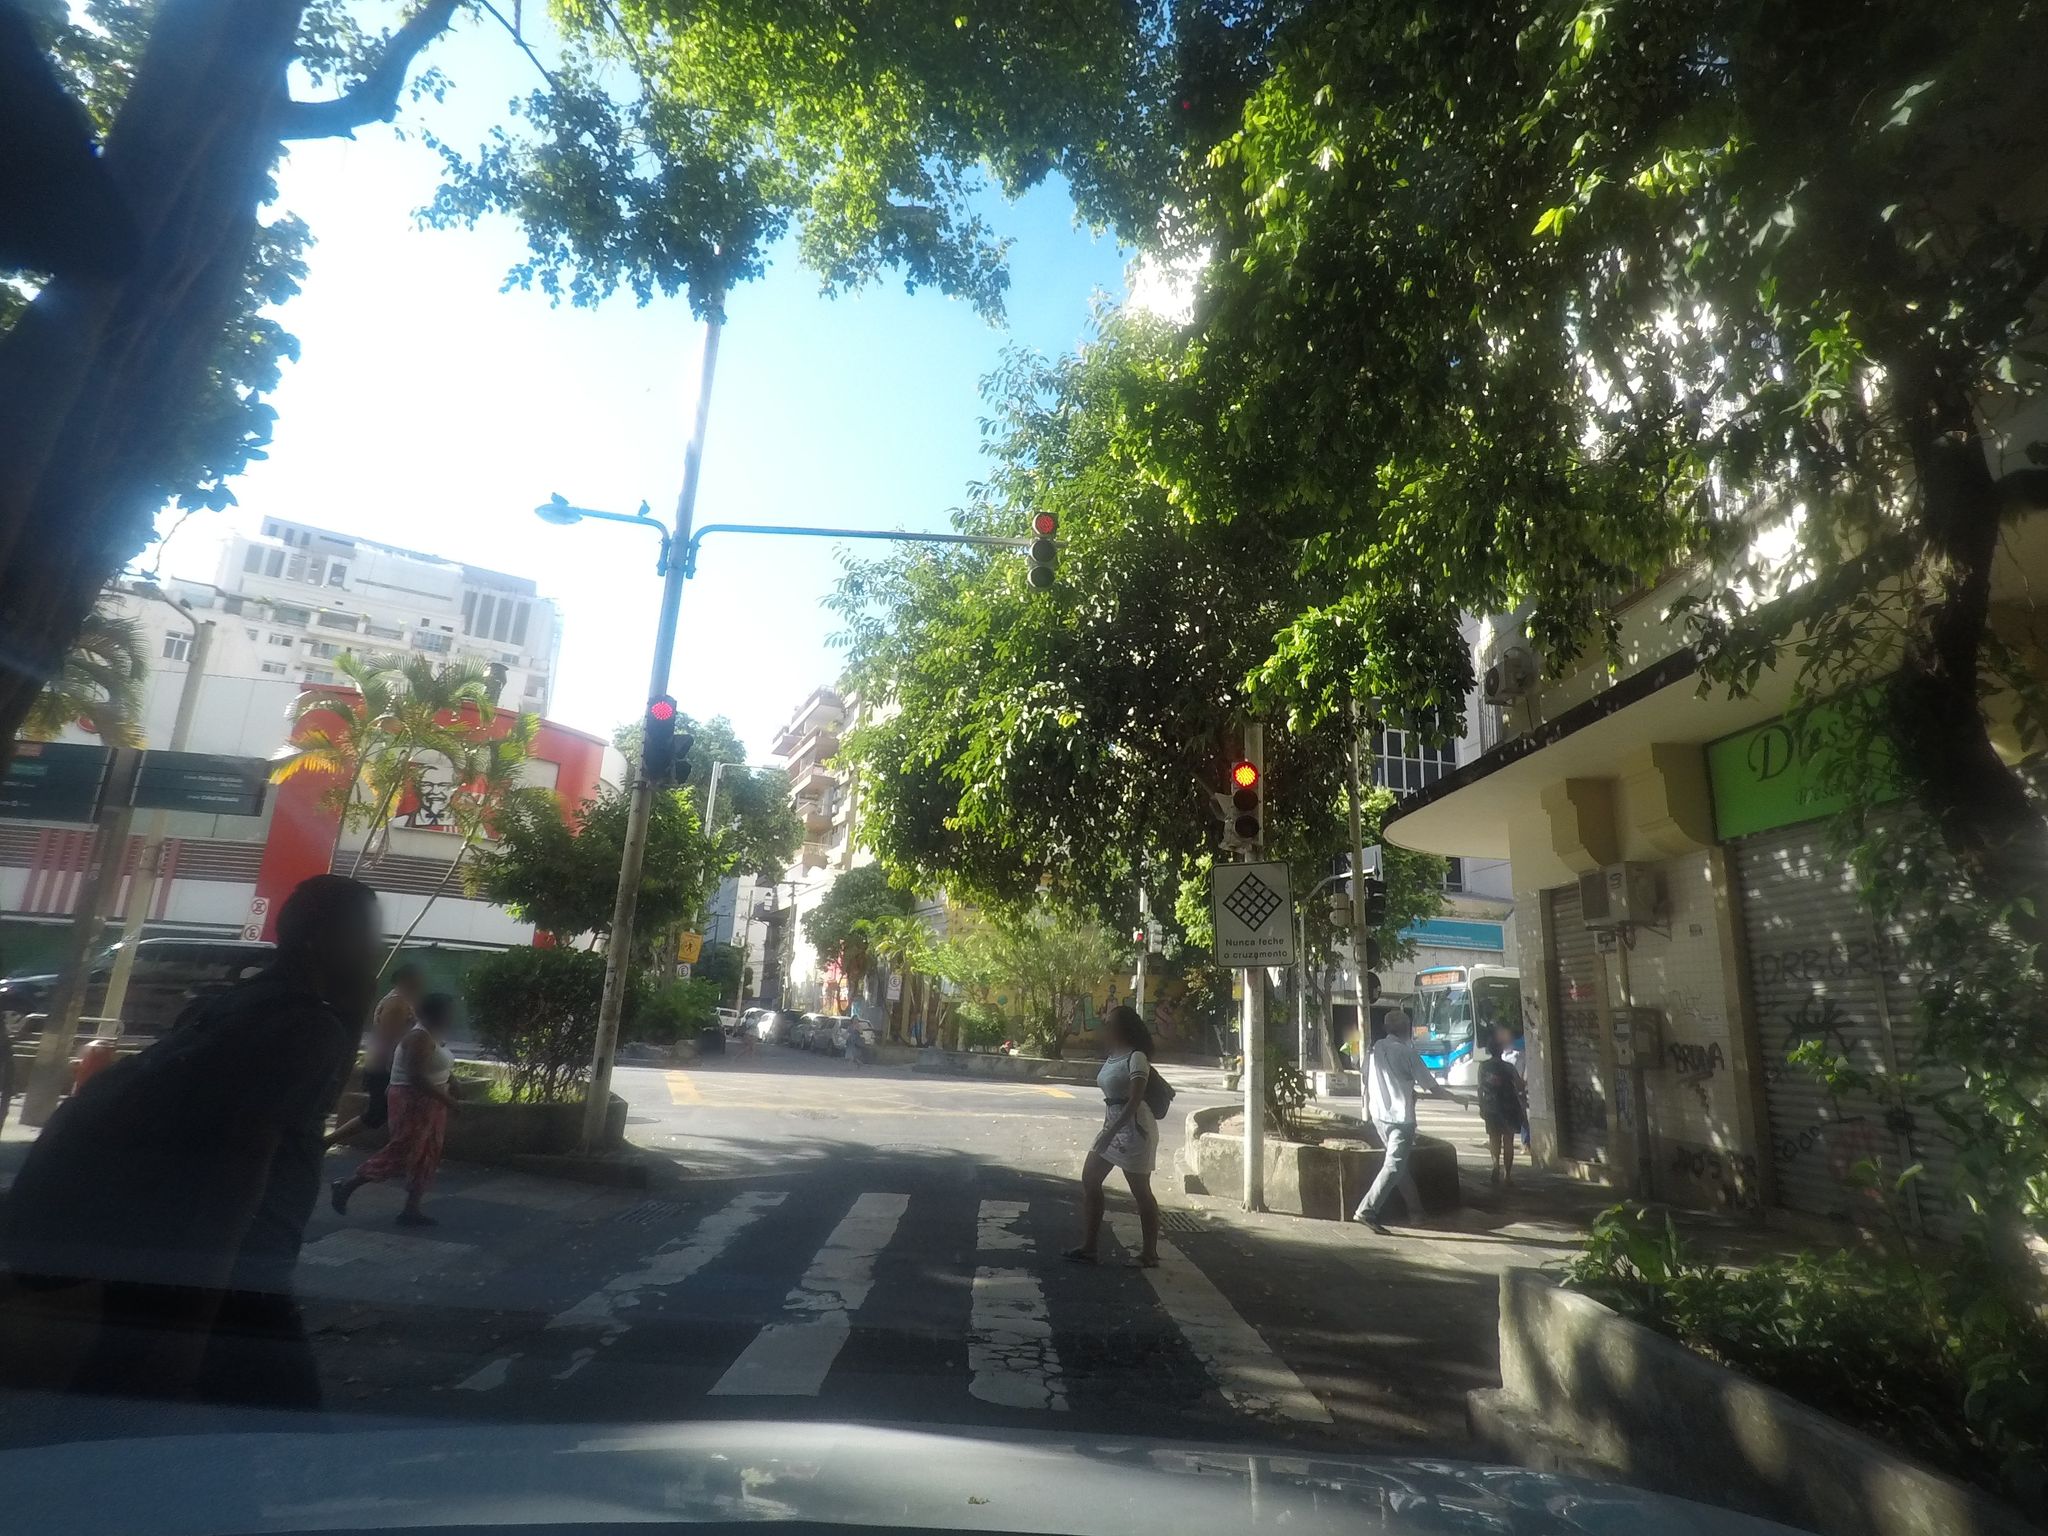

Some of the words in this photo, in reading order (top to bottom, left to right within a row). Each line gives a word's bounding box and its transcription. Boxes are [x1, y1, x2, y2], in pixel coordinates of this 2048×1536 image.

[1225, 938, 1256, 946] Nunca
[1259, 937, 1284, 946] feche
[1233, 951, 1288, 960] cruzamento
